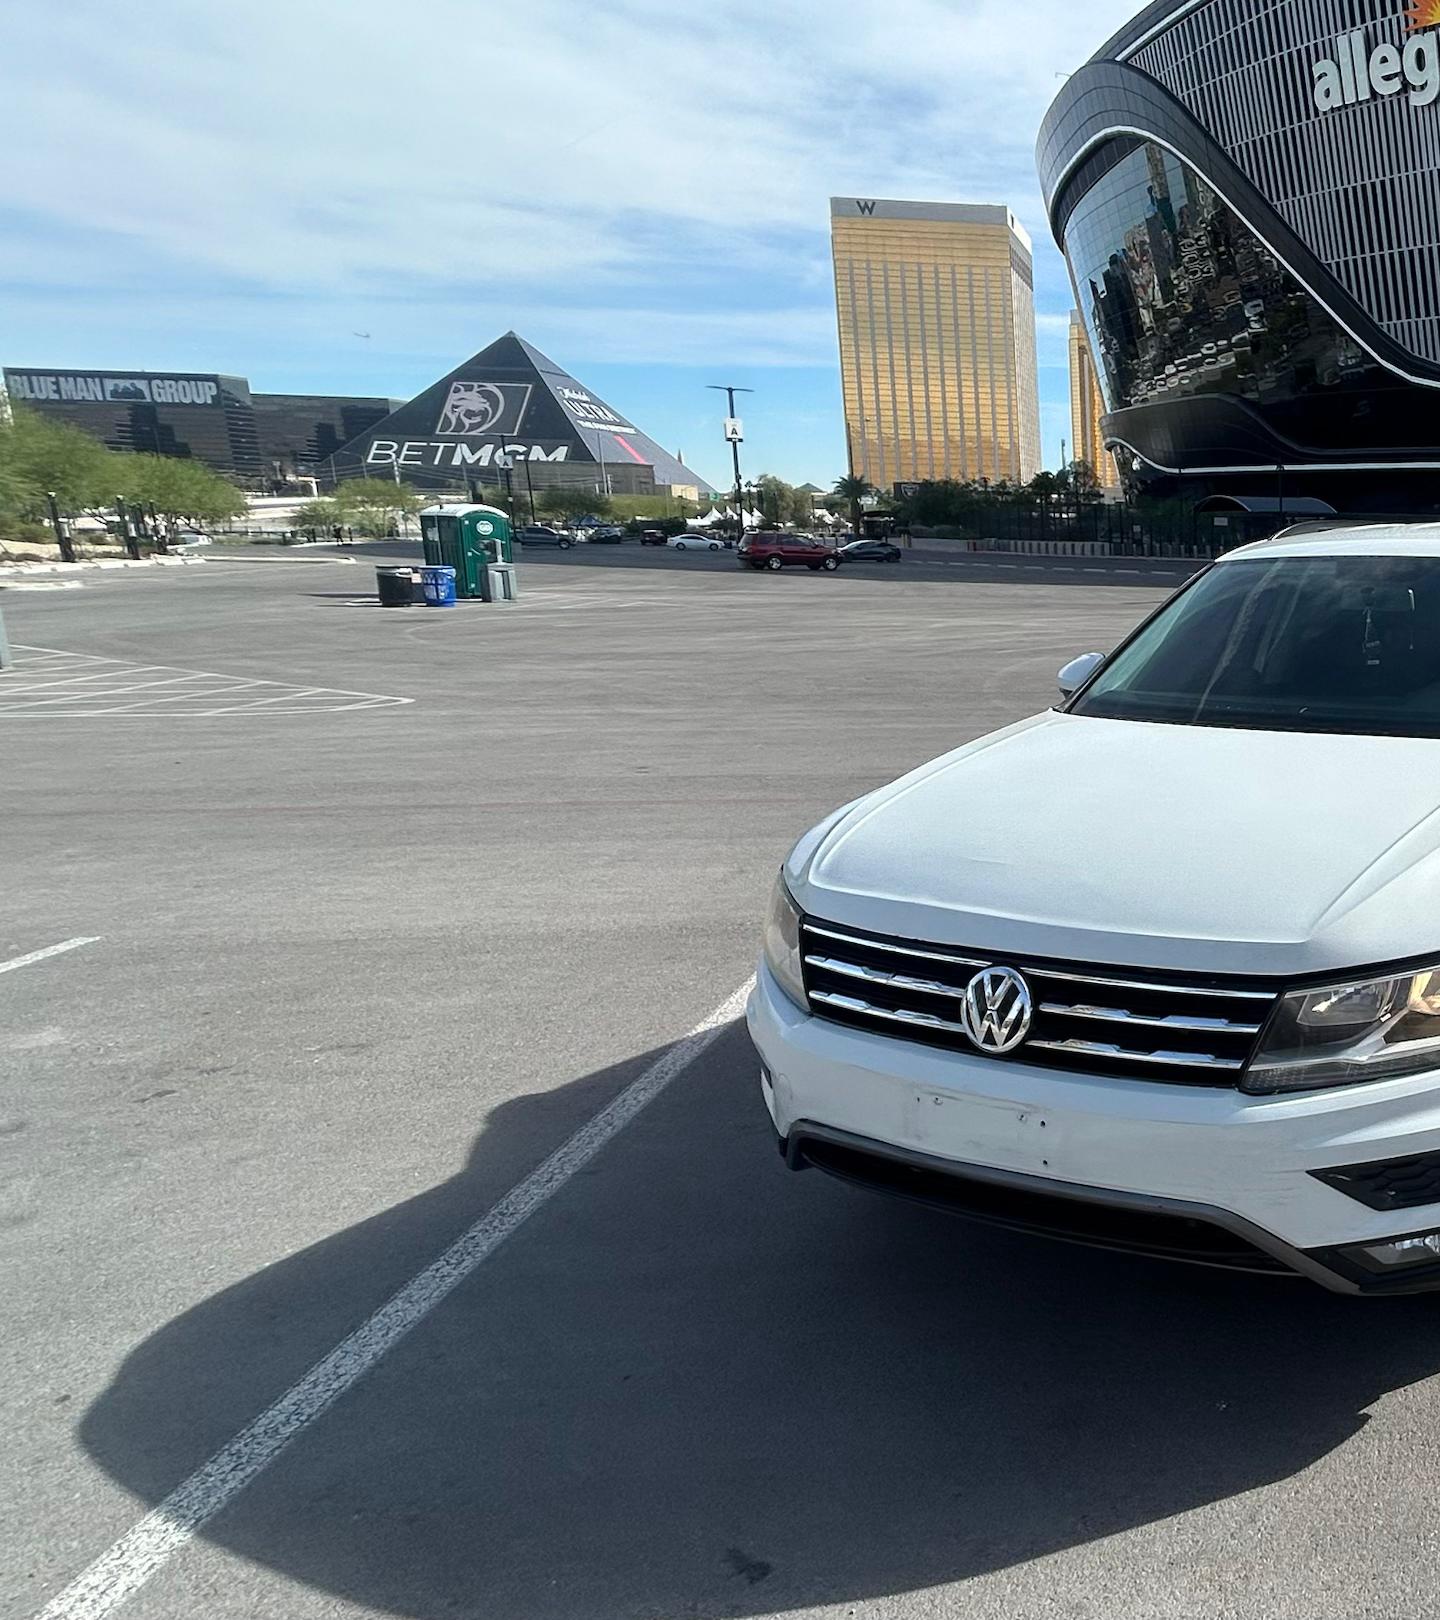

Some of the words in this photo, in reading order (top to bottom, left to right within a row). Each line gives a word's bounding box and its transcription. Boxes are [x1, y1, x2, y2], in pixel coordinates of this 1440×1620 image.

[856, 200, 876, 216] W
[58, 376, 104, 401] MAN
[152, 379, 218, 405] GROUP
[563, 400, 620, 422] ULTRA
[366, 440, 569, 466] BETMGM
[960, 966, 1033, 1052] VW
